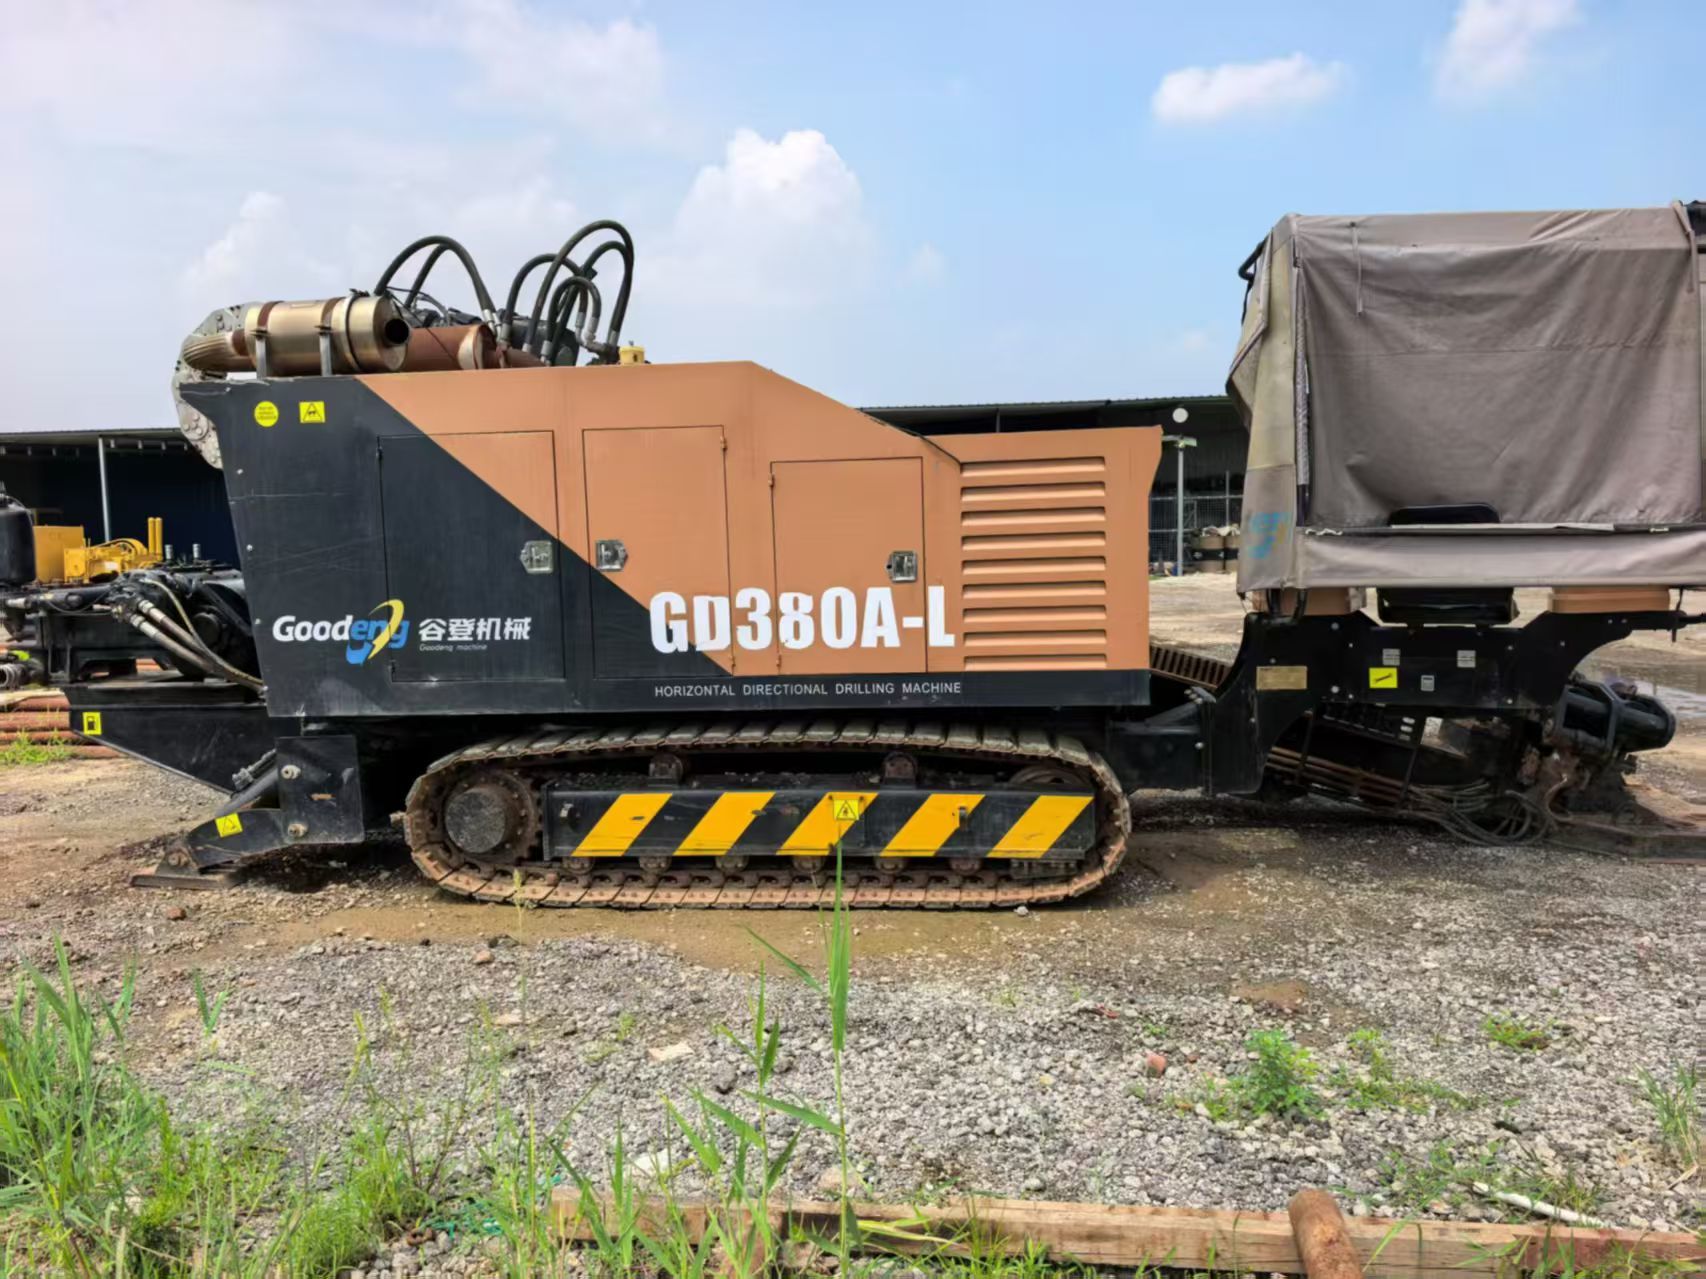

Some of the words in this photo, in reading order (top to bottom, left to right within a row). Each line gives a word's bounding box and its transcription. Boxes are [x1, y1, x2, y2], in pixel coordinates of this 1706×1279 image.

[272, 612, 410, 652] Goodeng
[419, 617, 532, 641] 谷登机械
[651, 586, 955, 653] GD380A-L
[655, 685, 736, 697] HORIZONTAL
[743, 684, 828, 696] DIRECTIONAL
[835, 683, 895, 695] DRILLING
[902, 682, 961, 694] MACHINE
